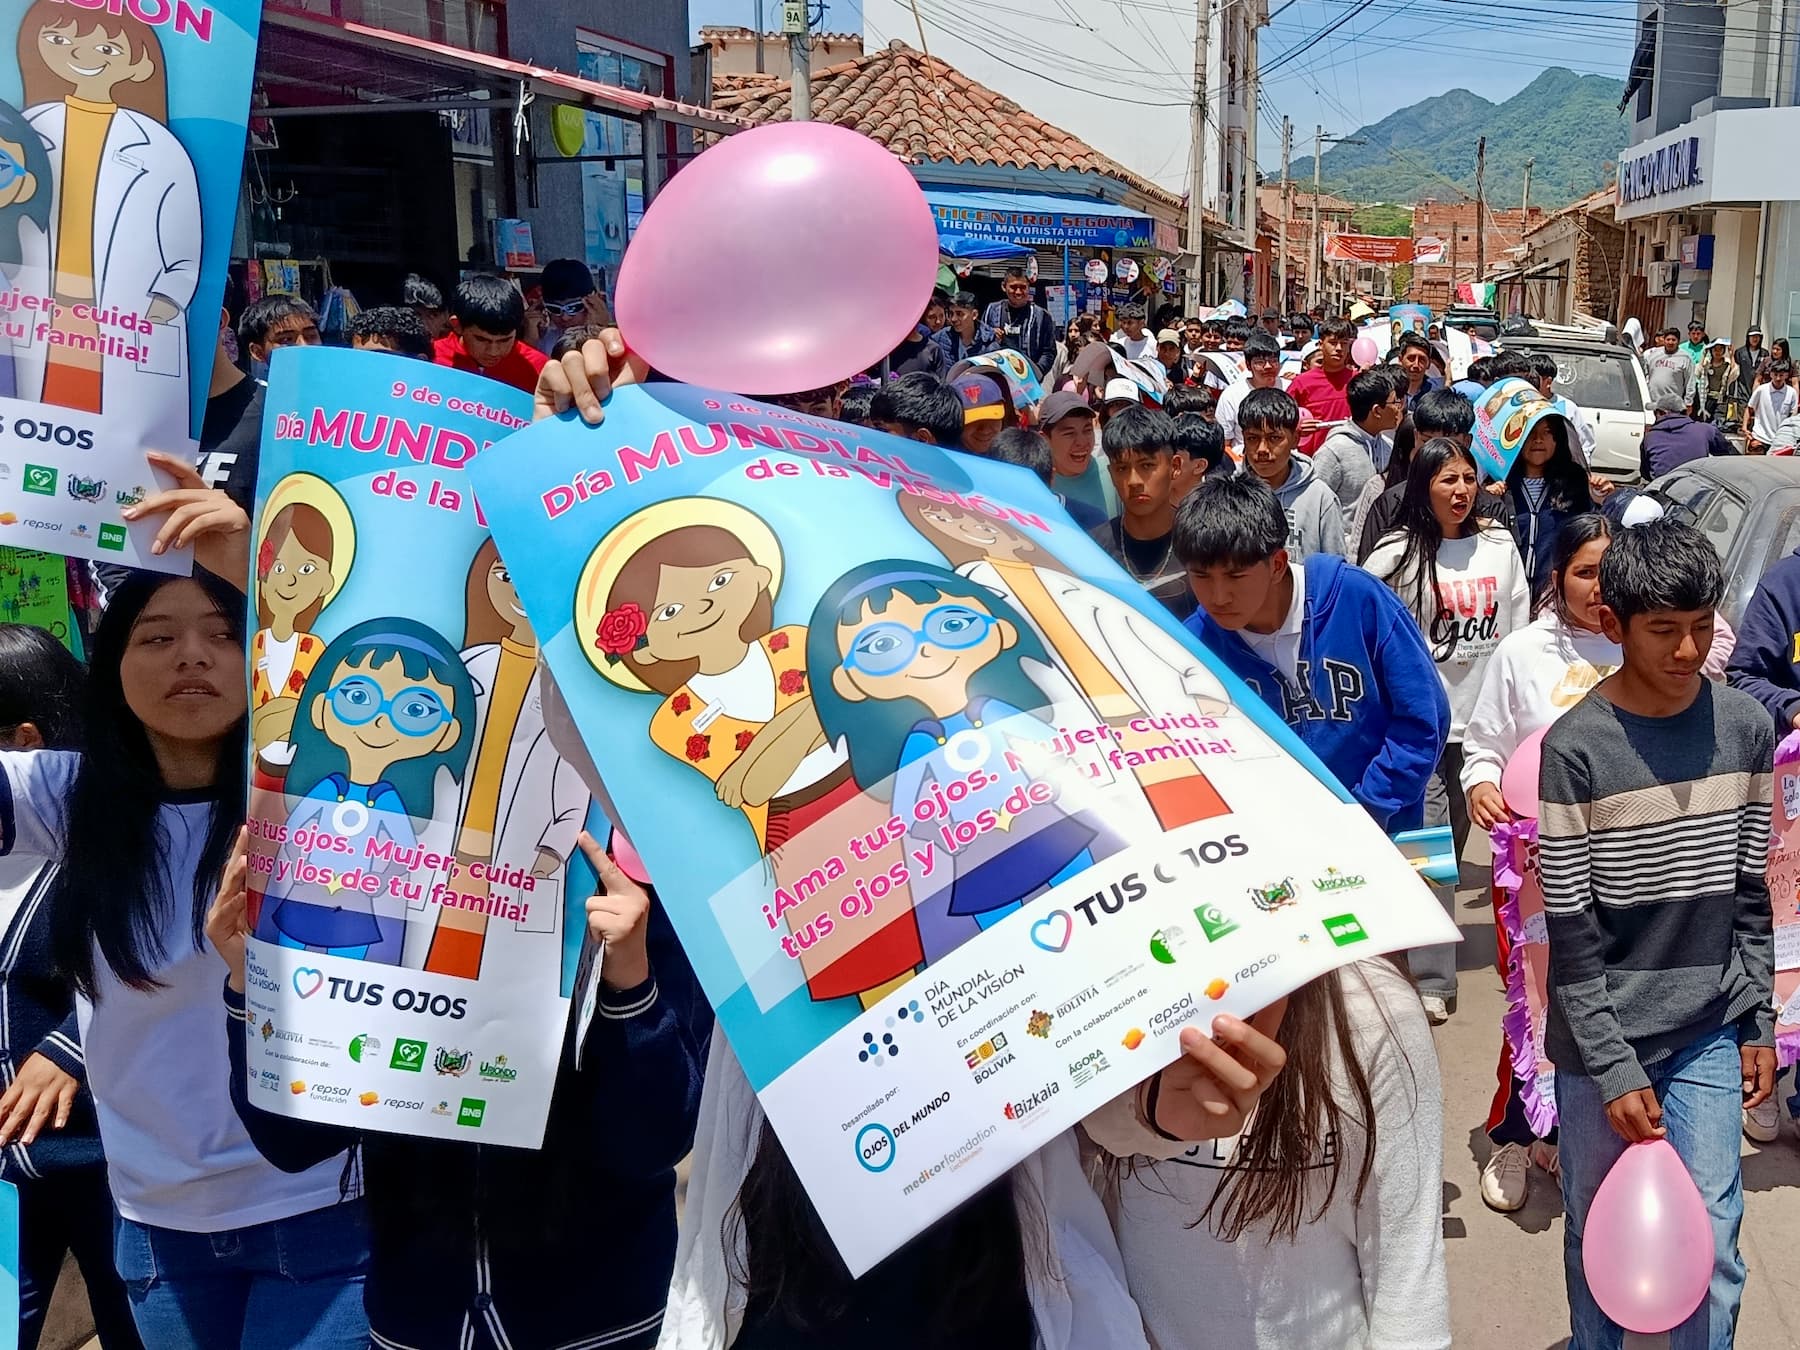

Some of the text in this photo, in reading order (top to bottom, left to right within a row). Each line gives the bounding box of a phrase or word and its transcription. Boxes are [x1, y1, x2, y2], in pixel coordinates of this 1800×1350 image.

[786, 11, 800, 22] 9A
[936, 207, 1134, 230] TICENTRO SEGOVIA
[942, 220, 1099, 237] TIENDA MAYORISTA ENTEL
[0, 288, 153, 336] ujer, cuida
[36, 323, 149, 364] familia!
[391, 381, 406, 397] 9
[411, 387, 441, 405] de
[14, 418, 94, 450] OJOS
[274, 407, 494, 471] Día MUND
[703, 399, 861, 439] 9 de octubre
[370, 470, 418, 502] de
[427, 480, 462, 512] la
[541, 469, 615, 520] Día
[615, 422, 930, 484] MUNDIAL
[745, 458, 1052, 534] de la VISIÓN
[23, 516, 63, 532] repsol
[101, 532, 123, 543] BNB
[1130, 712, 1219, 734] cuida
[263, 817, 288, 843] tus
[293, 824, 355, 855] ojos.
[365, 837, 459, 877] Mujer,
[468, 860, 536, 893] cuida
[761, 767, 998, 930] ¡Ama tus ojos.
[780, 738, 1237, 959] tus ojos y los de u familia!
[275, 858, 291, 882] y
[294, 858, 331, 885] los
[340, 867, 380, 893] de
[388, 875, 422, 901] tu
[431, 882, 530, 922] familia!
[1073, 872, 1147, 926] TUS
[328, 976, 468, 1020] TUS OJOS
[924, 979, 950, 1003] DÍA
[930, 968, 995, 1016] MUNDIAL
[937, 964, 1026, 1028] DE LA VISIÓN
[1056, 986, 1100, 1019] BOLIVIA
[1149, 992, 1193, 1029] repsol
[956, 991, 1039, 1049] En coordinación con:
[1055, 1033, 1074, 1049] Con
[1073, 1028, 1082, 1038] la
[1082, 994, 1137, 1031] colaboración
[1152, 1007, 1199, 1039] fundación
[280, 1053, 319, 1067] colaboración
[974, 1053, 1016, 1085] BOLIVIA
[1069, 1048, 1104, 1076] ÁGORA
[310, 1093, 348, 1104] fundación
[311, 1082, 352, 1097] repsol
[384, 1097, 425, 1111] repsol
[841, 1085, 902, 1133] Desarrollado por:
[1013, 1080, 1061, 1120] Bizkaia
[461, 1107, 482, 1118] BNB
[862, 1090, 951, 1160] OJOS DEL MUNDO
